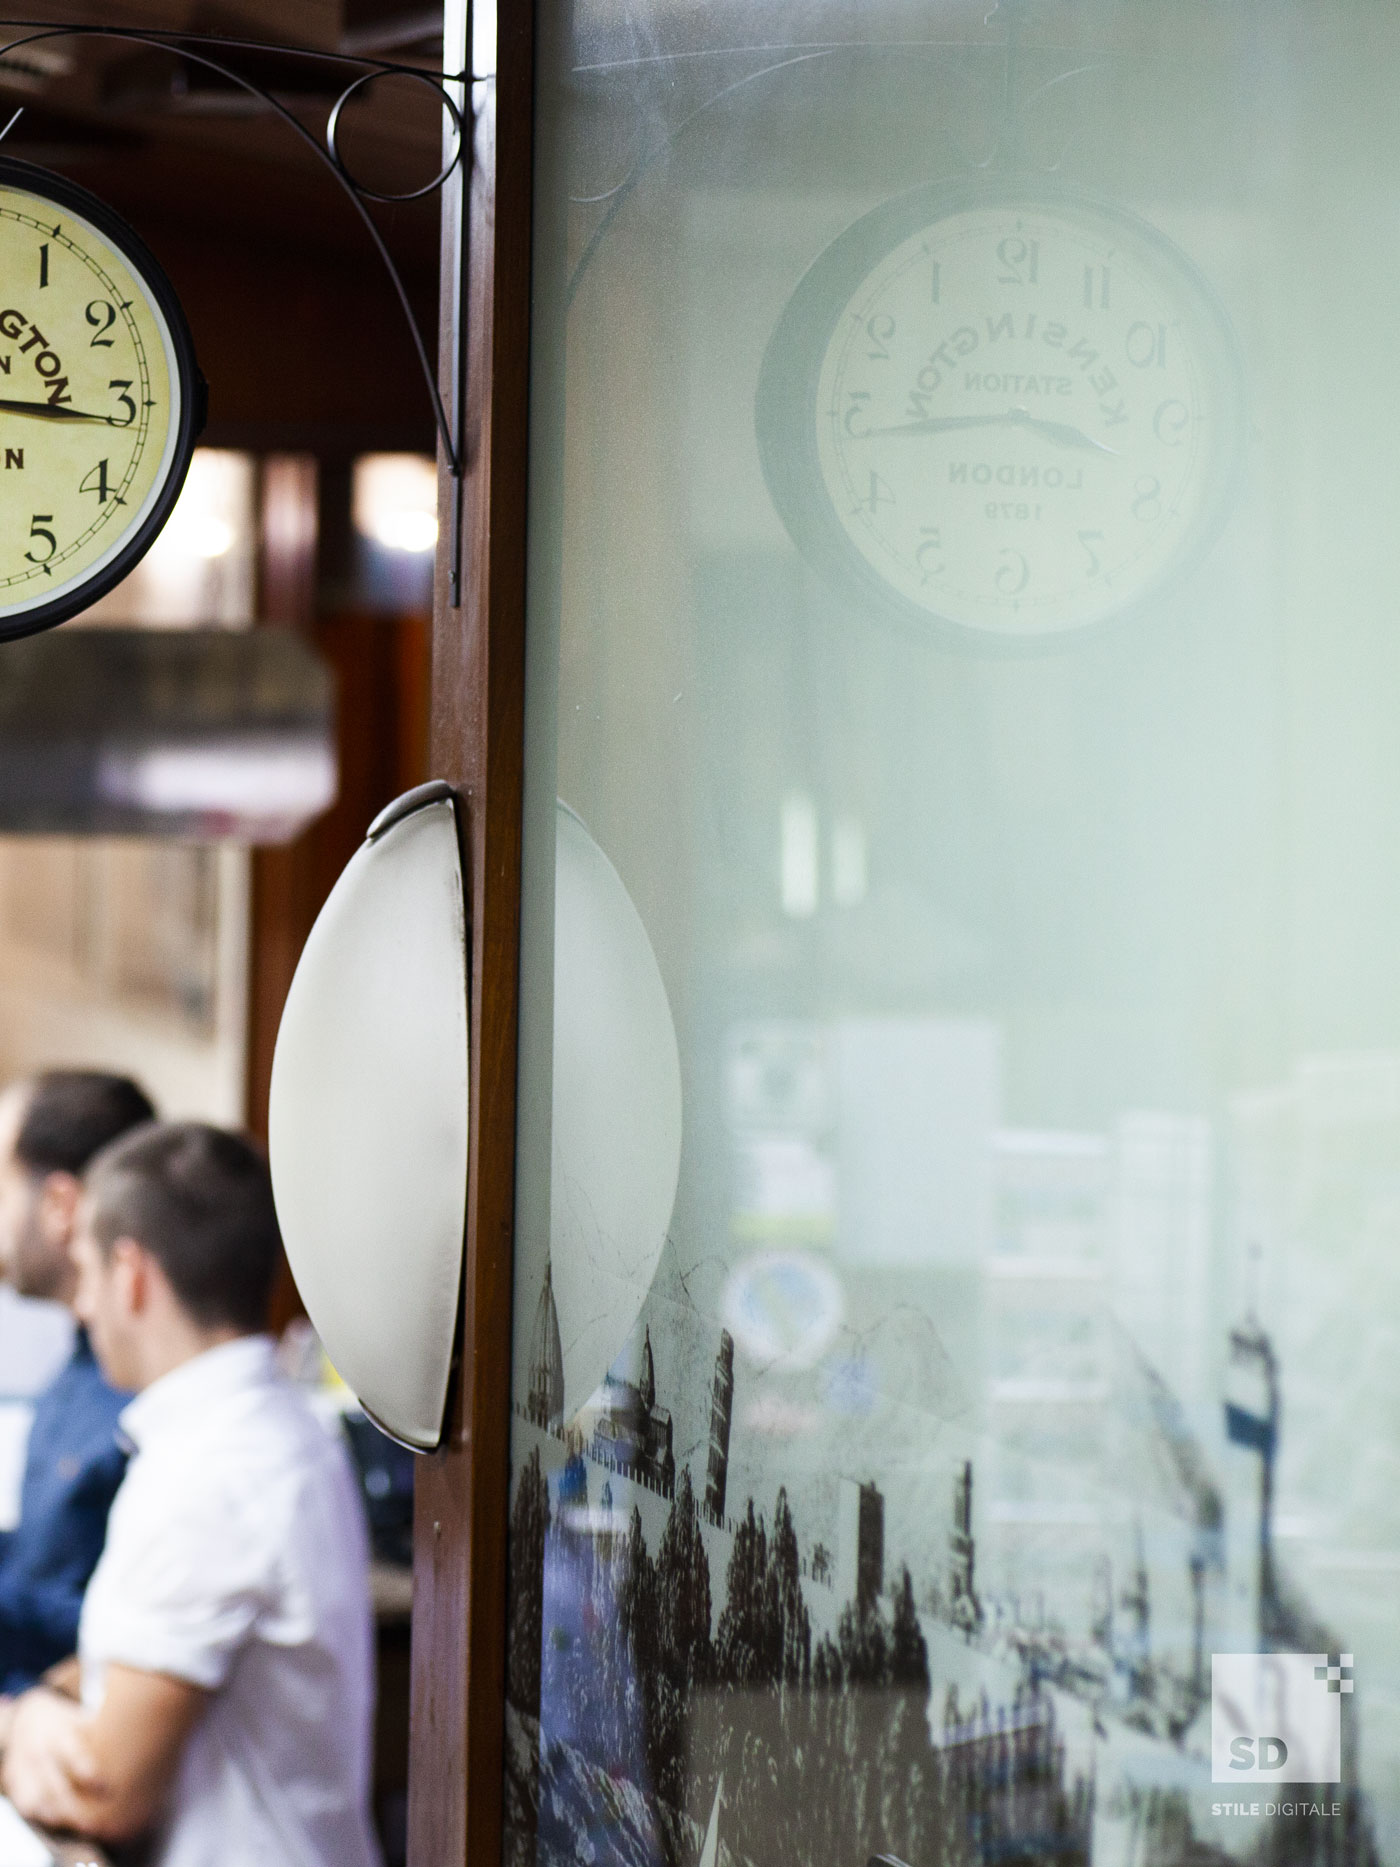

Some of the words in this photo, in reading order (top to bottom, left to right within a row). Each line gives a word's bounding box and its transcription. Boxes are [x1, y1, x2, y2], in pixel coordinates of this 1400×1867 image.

[39, 243, 50, 289] 1
[85, 300, 117, 348] 2
[106, 380, 137, 427] 3
[79, 458, 117, 505] 4
[24, 514, 57, 563] 5
